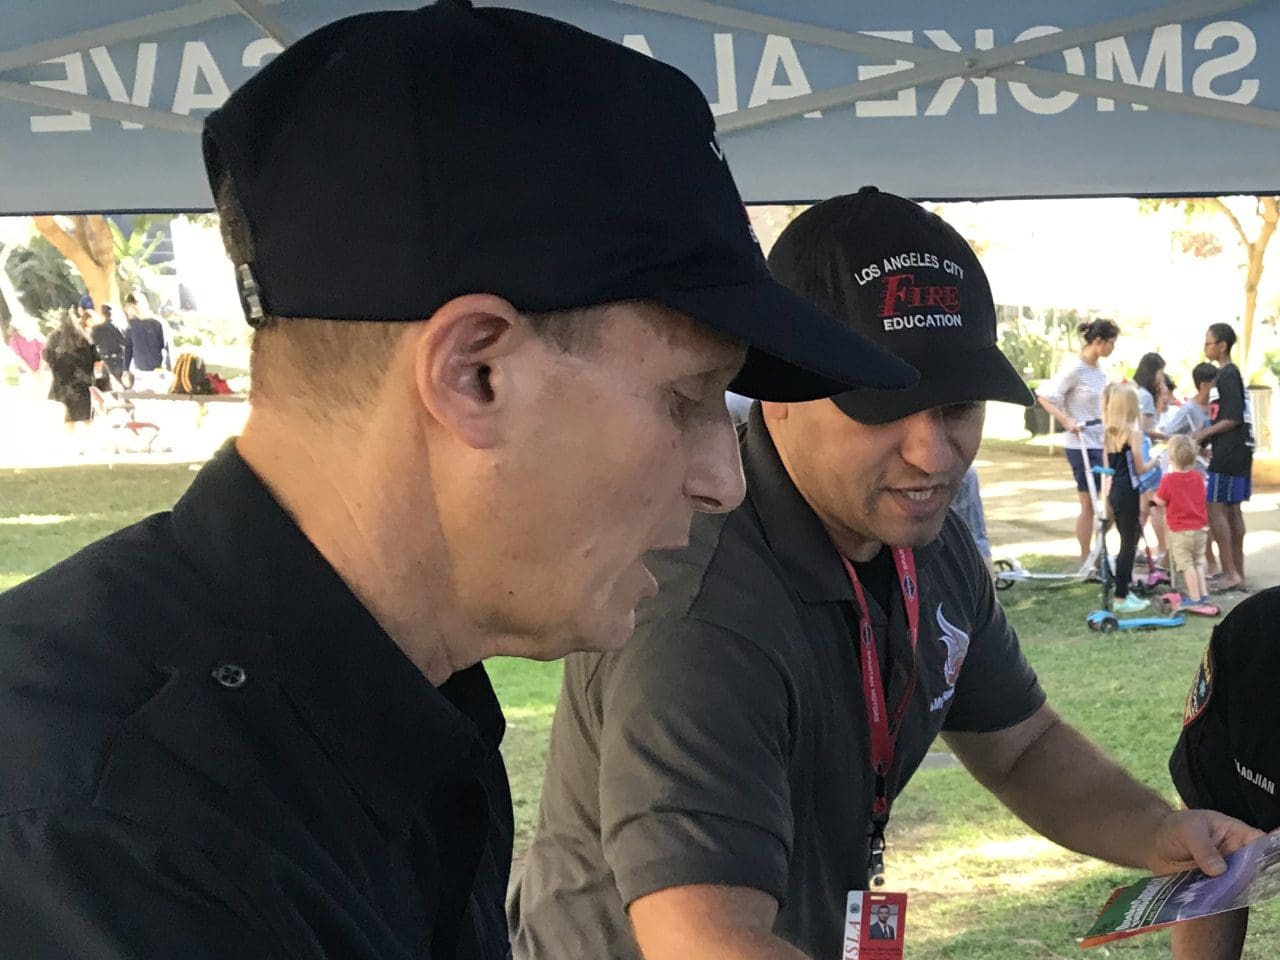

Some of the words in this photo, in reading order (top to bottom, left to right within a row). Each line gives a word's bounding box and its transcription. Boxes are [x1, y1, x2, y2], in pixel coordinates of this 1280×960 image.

[854, 264, 881, 285] LOS
[883, 252, 940, 273] ANGELES
[943, 260, 964, 280] CITY
[883, 314, 962, 331] EDUCATION
